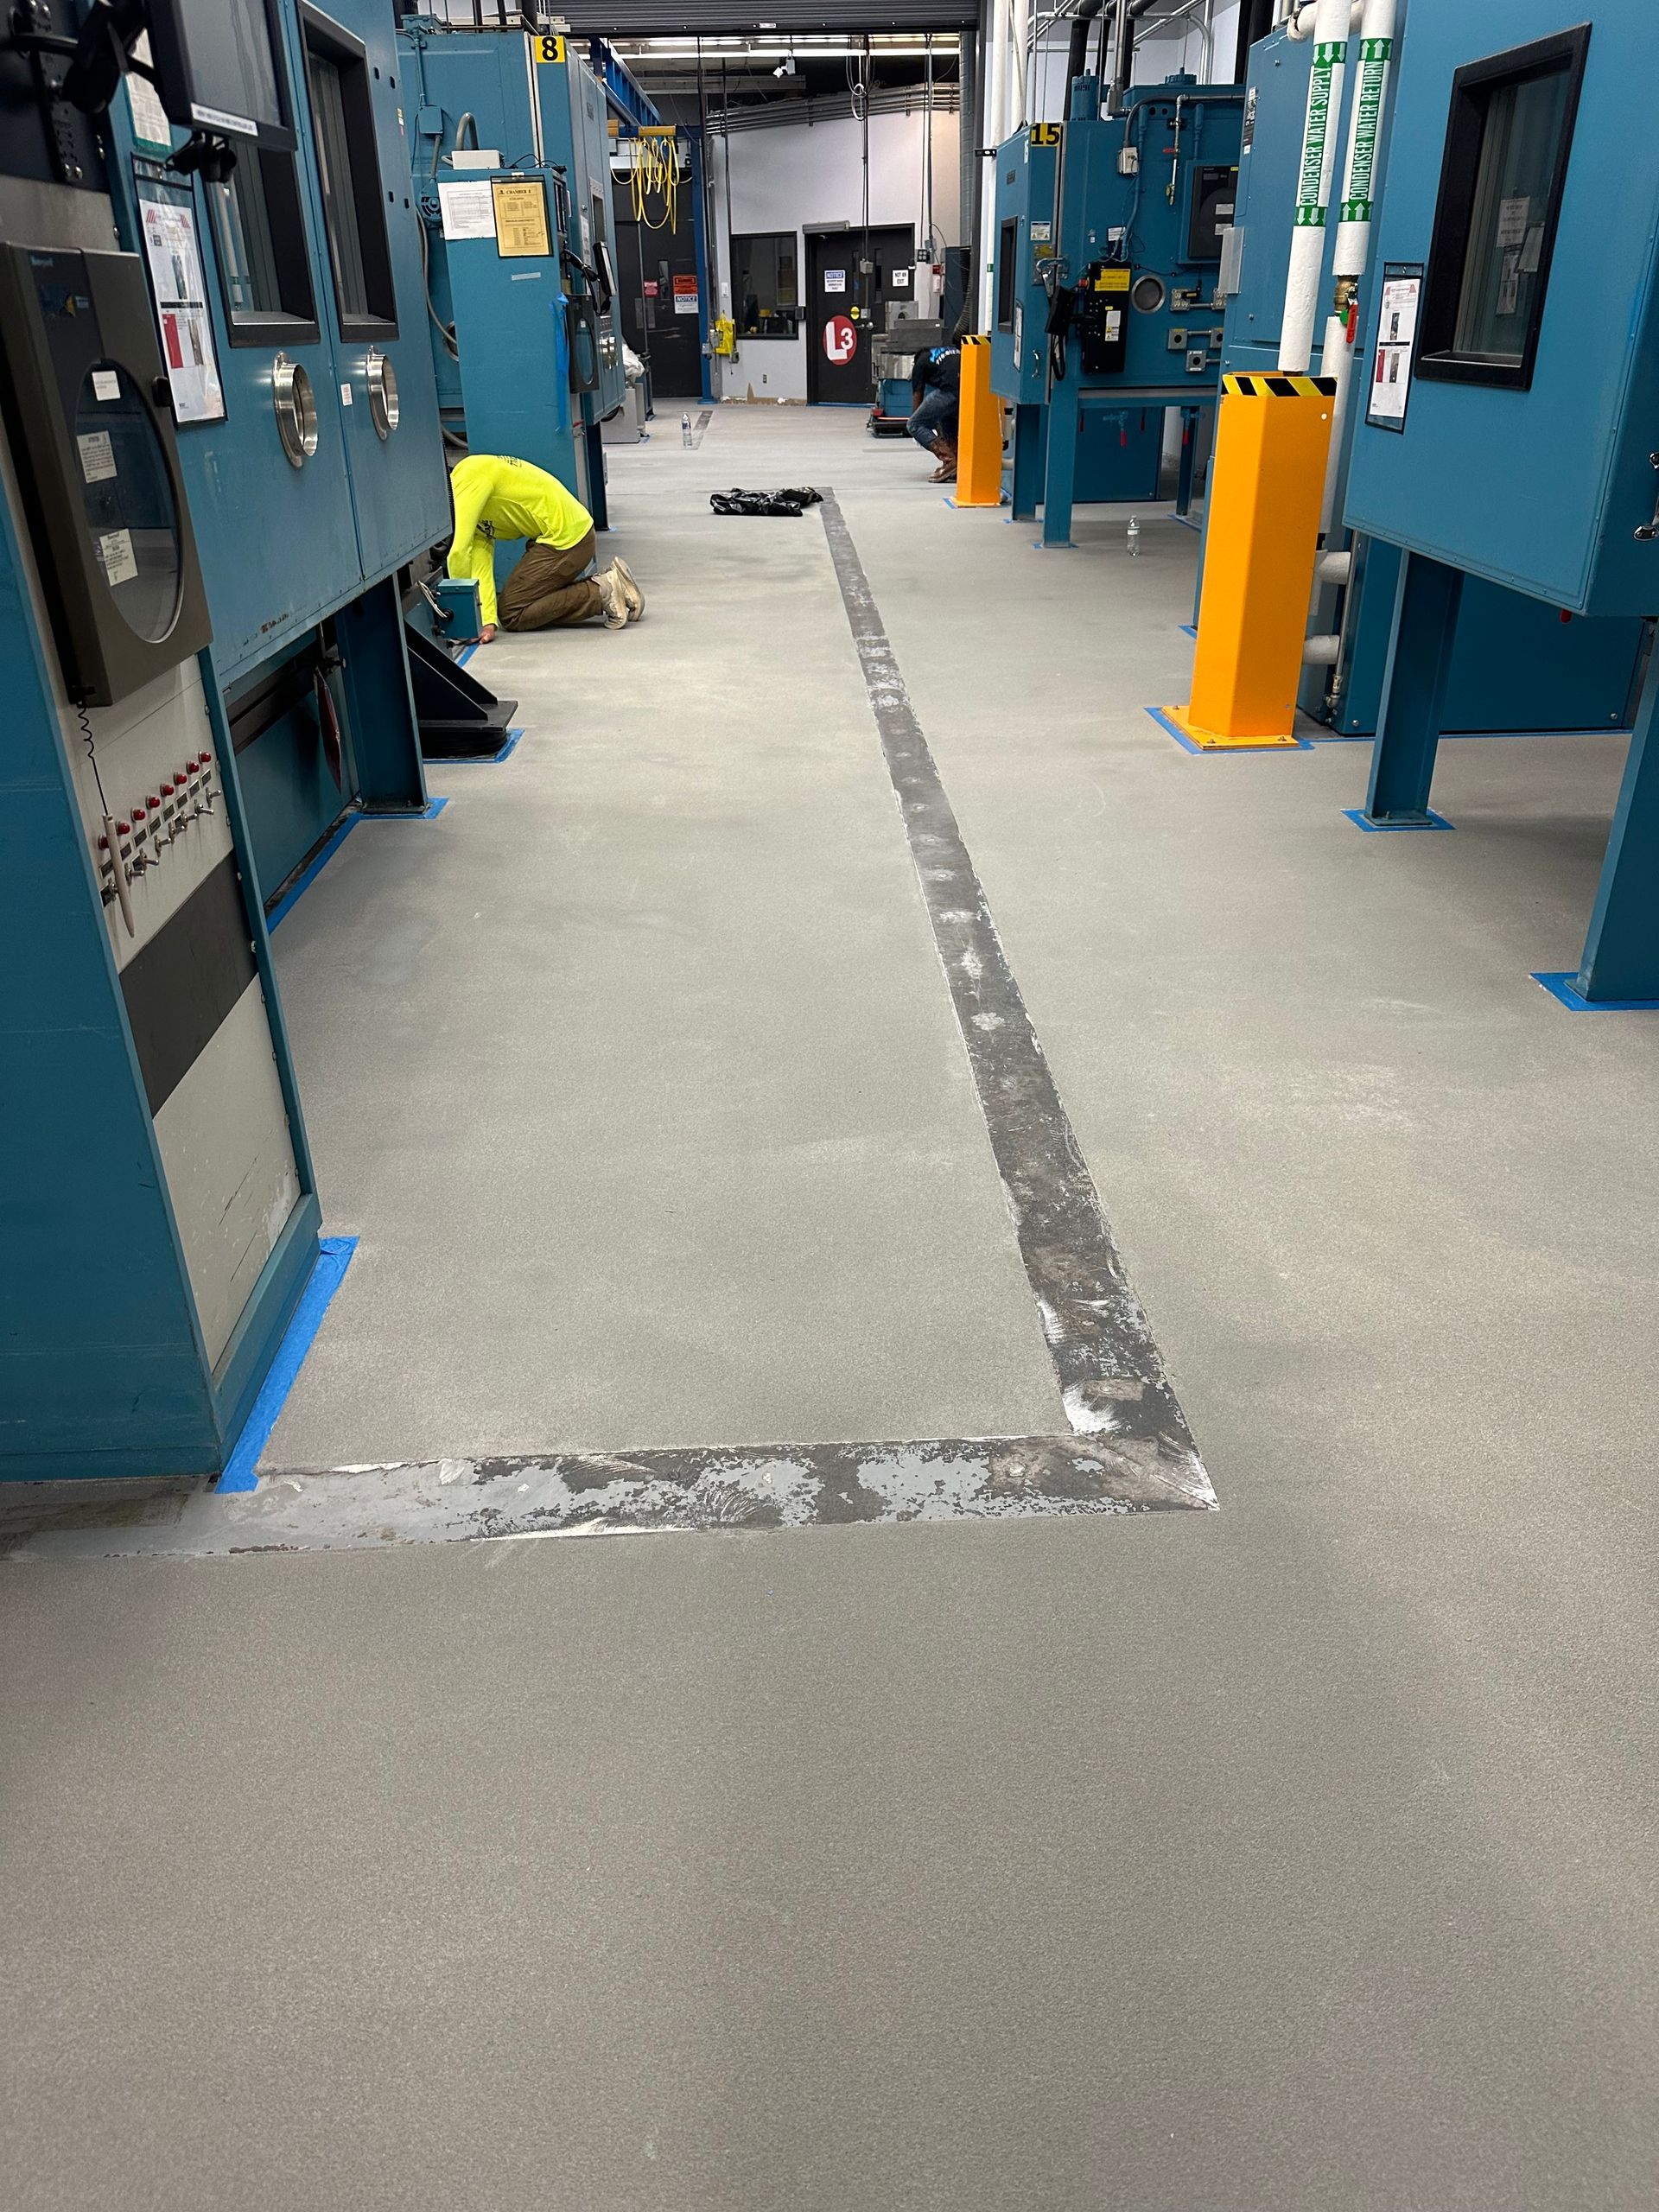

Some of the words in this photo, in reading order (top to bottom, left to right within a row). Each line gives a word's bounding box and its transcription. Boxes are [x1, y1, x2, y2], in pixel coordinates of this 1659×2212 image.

[542, 36, 558, 61] 8
[1311, 67, 1332, 106] SUPPLY
[1361, 61, 1383, 102] RETURN
[1031, 123, 1060, 145] 15
[1306, 106, 1327, 145] WATER
[1357, 103, 1378, 141] WATER
[1300, 147, 1323, 206] CONDENSER
[1349, 142, 1373, 200] CONDENSER
[825, 321, 854, 361] L3
